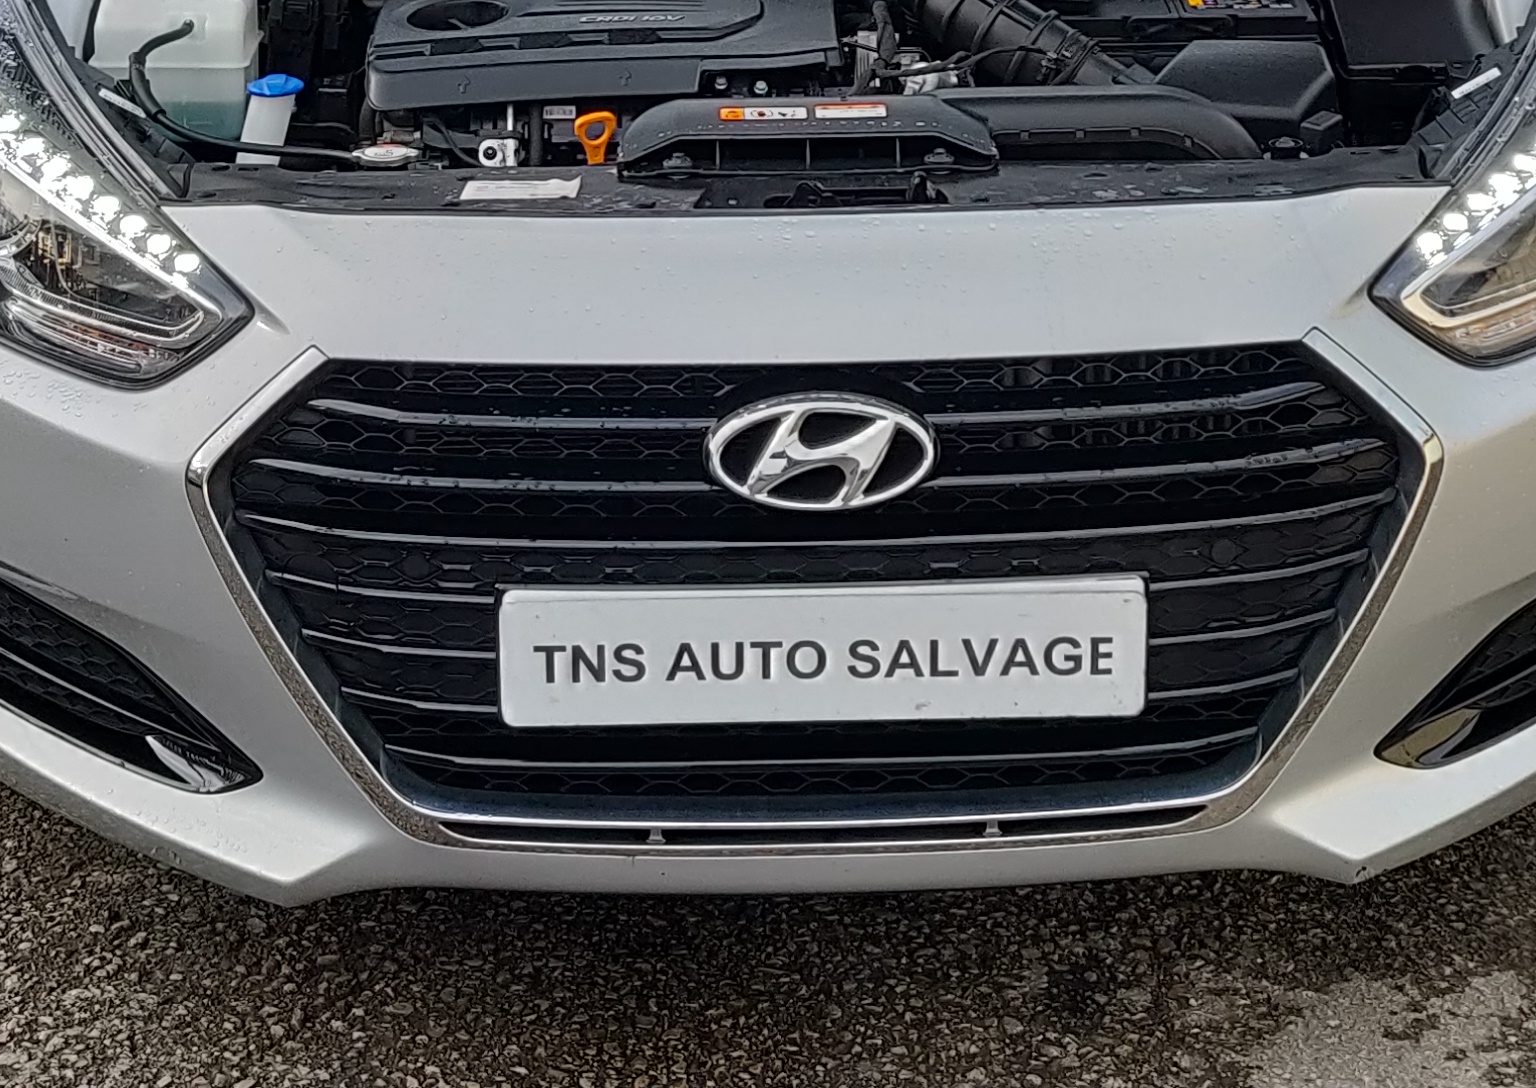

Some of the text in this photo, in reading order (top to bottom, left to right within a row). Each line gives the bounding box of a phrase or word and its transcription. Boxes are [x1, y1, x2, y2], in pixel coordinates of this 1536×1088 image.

[532, 635, 1114, 684] TNS AUTO SALVAGE
